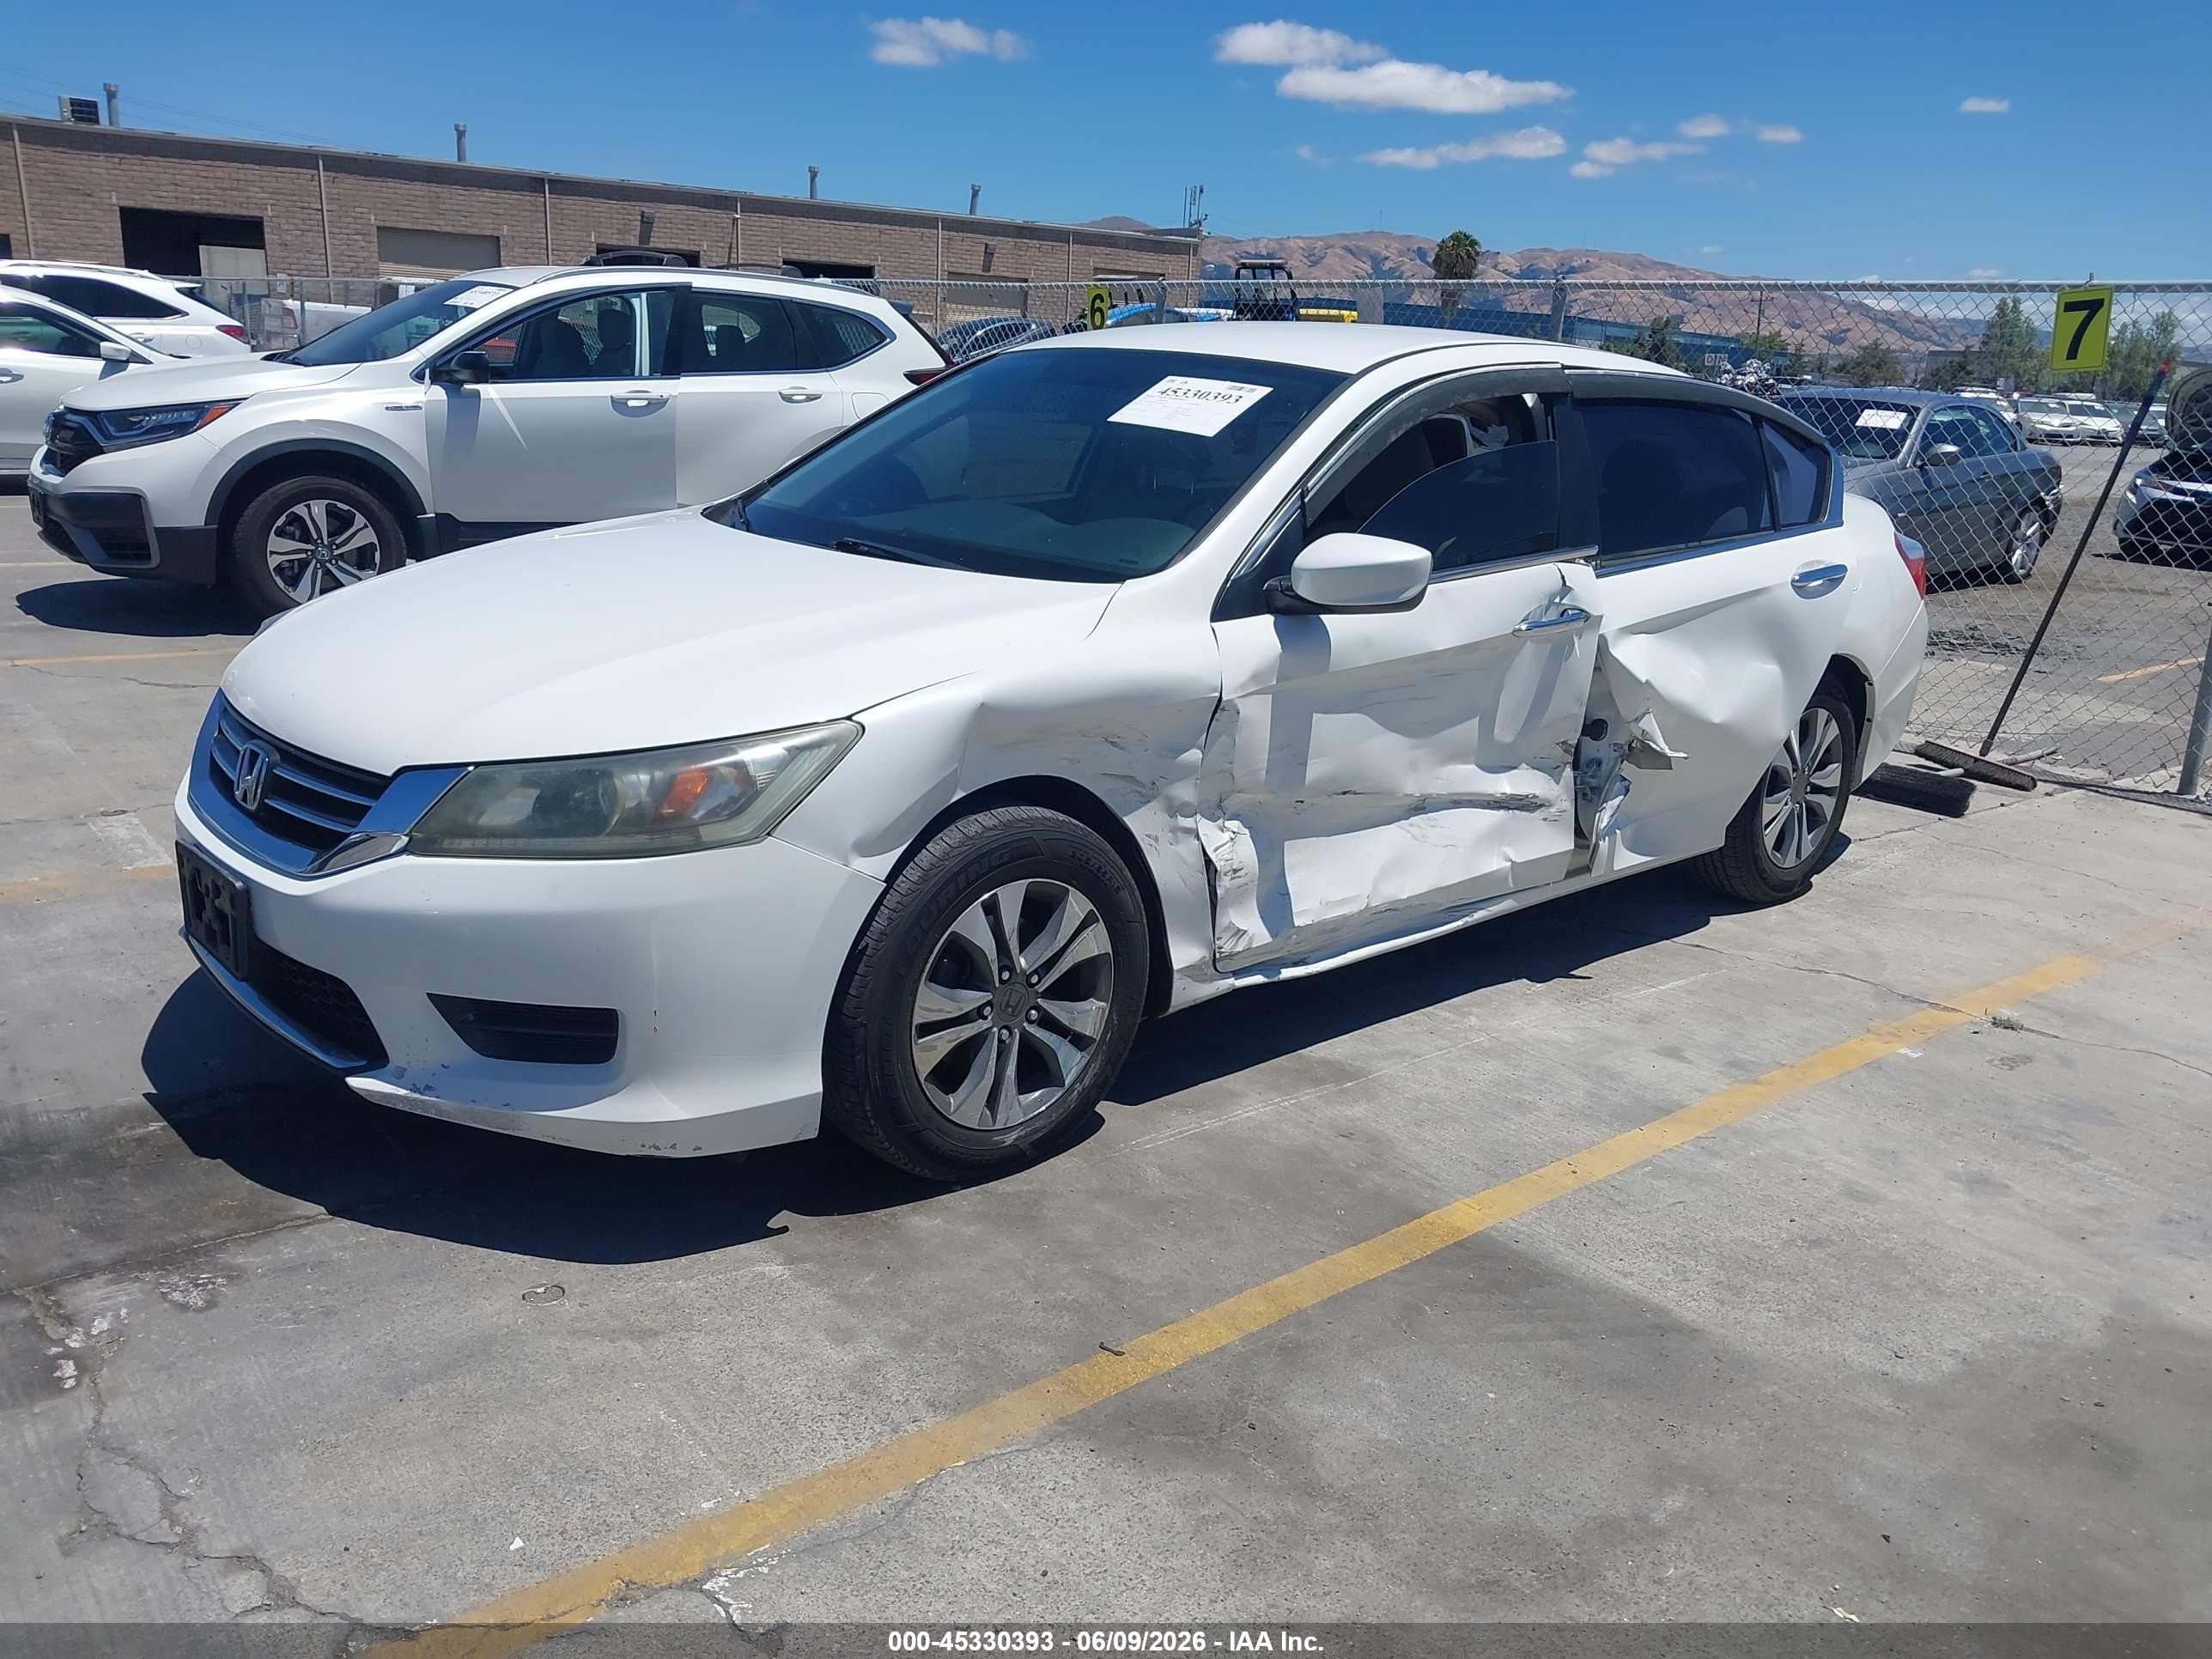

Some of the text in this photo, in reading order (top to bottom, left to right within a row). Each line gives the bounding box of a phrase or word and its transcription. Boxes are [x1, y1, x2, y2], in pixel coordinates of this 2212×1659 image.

[1091, 293, 1105, 331] 6
[2063, 297, 2106, 361] 7
[1158, 386, 1243, 404] 45330393
